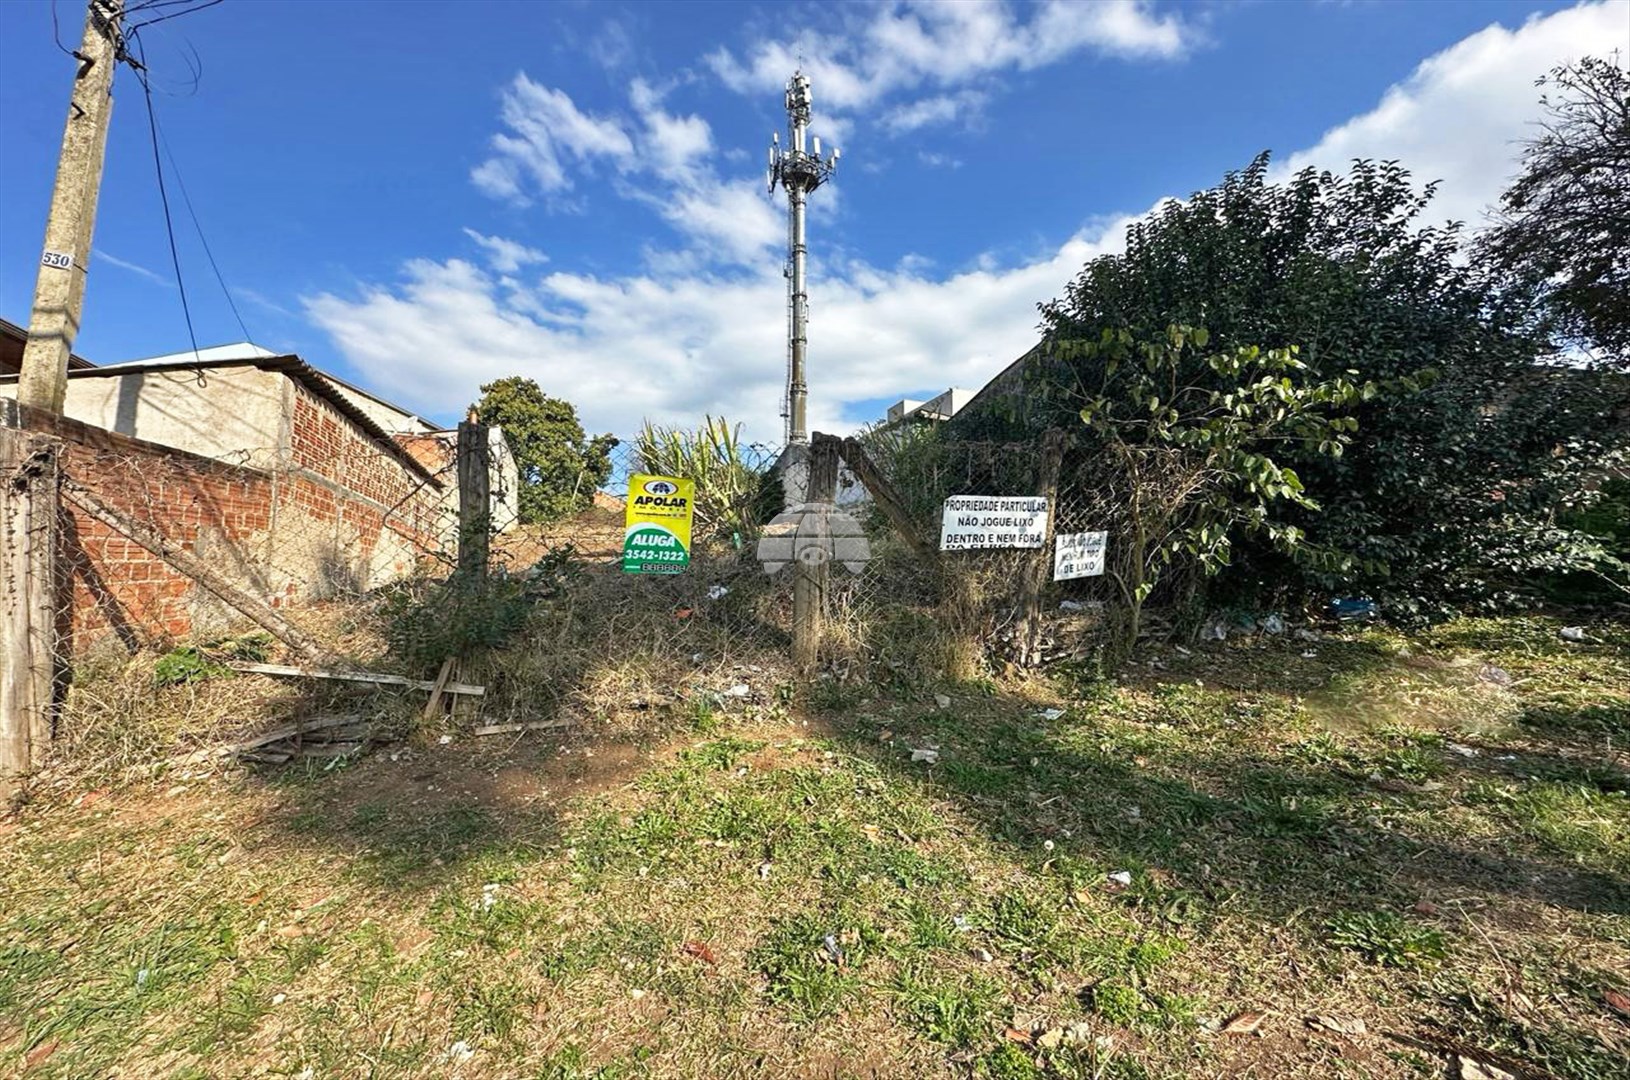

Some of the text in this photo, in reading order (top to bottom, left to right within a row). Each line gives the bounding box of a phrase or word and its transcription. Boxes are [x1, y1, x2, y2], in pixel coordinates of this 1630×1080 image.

[43, 252, 70, 267] 530
[634, 496, 687, 507] APOLAR
[945, 500, 1047, 512] PROPRIEDADE PARTICULAR
[957, 515, 1034, 527] NÃO JOGUE LIXO
[631, 534, 676, 547] ALUGA
[946, 533, 1041, 543] DENTRO E NEM FORA
[625, 549, 684, 561] 3542-1322
[1064, 561, 1095, 574] DE LIXO
